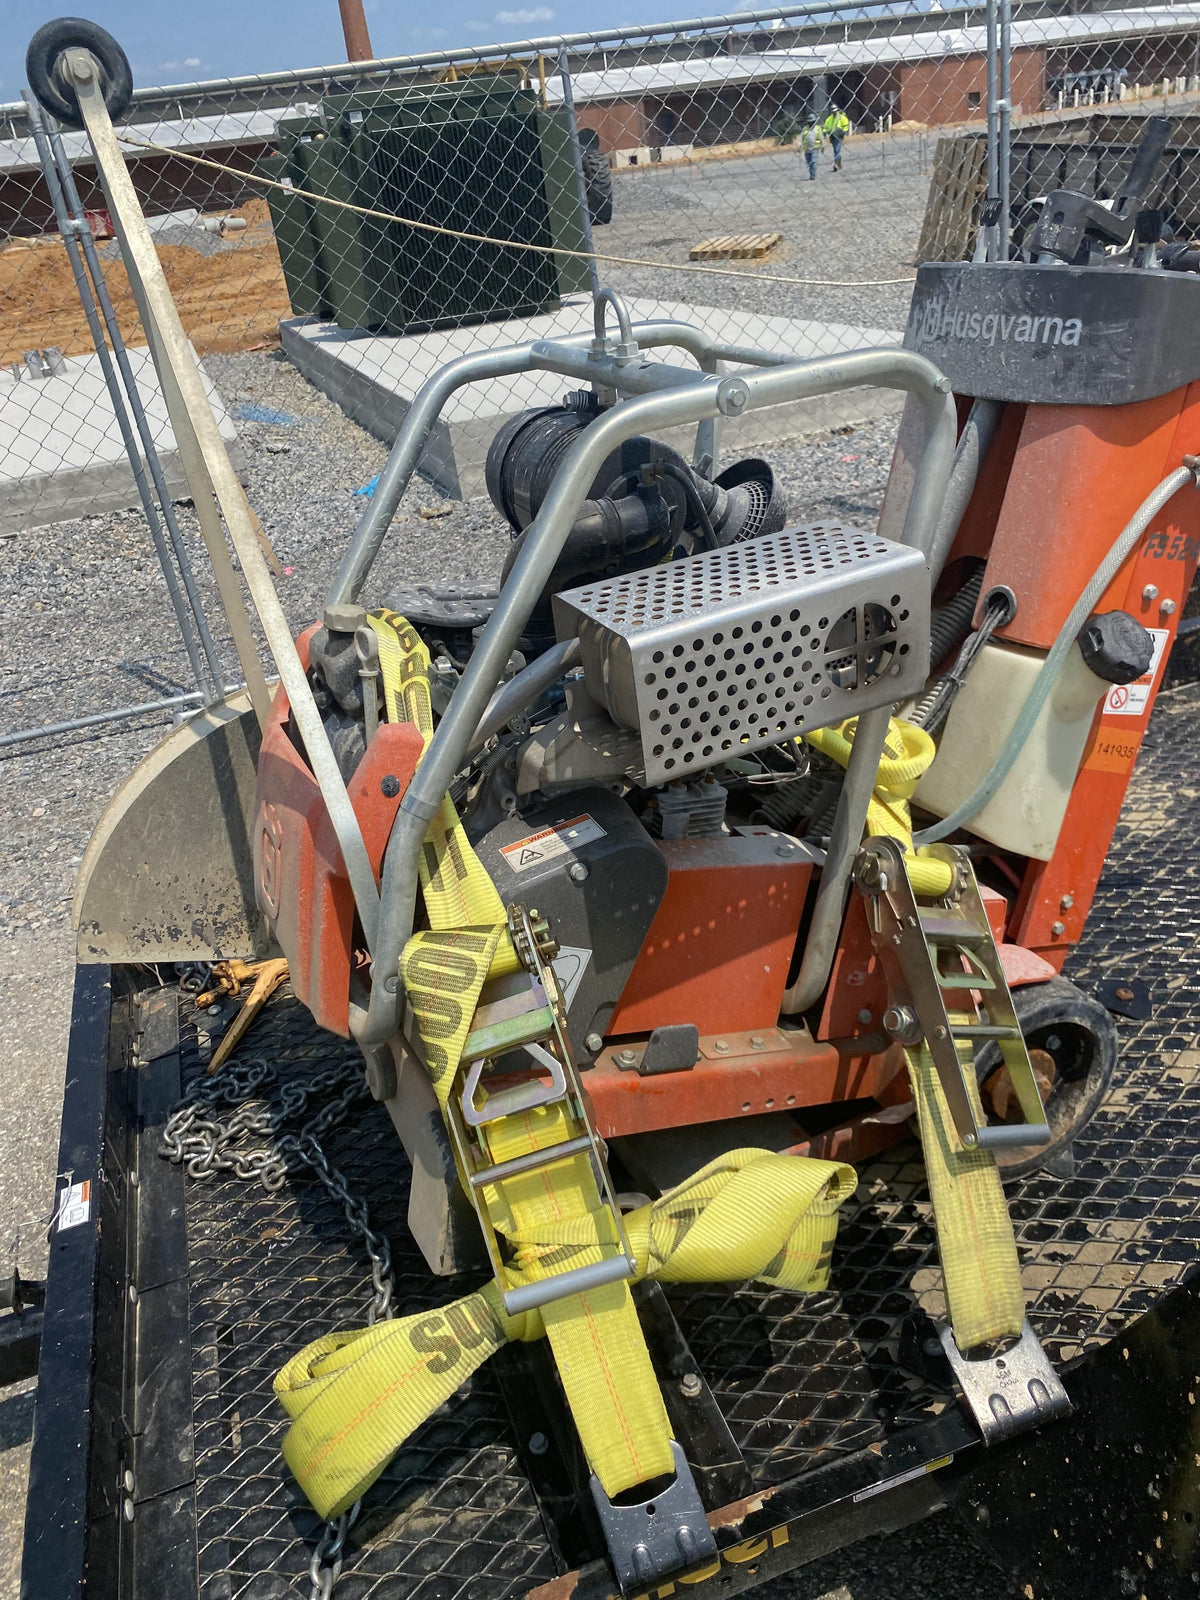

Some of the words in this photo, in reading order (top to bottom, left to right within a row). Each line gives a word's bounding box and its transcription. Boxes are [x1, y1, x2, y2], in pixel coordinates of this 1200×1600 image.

[939, 302, 1084, 347] Husqvarna
[1097, 742, 1135, 759] 141935
[527, 823, 569, 843] WARNING
